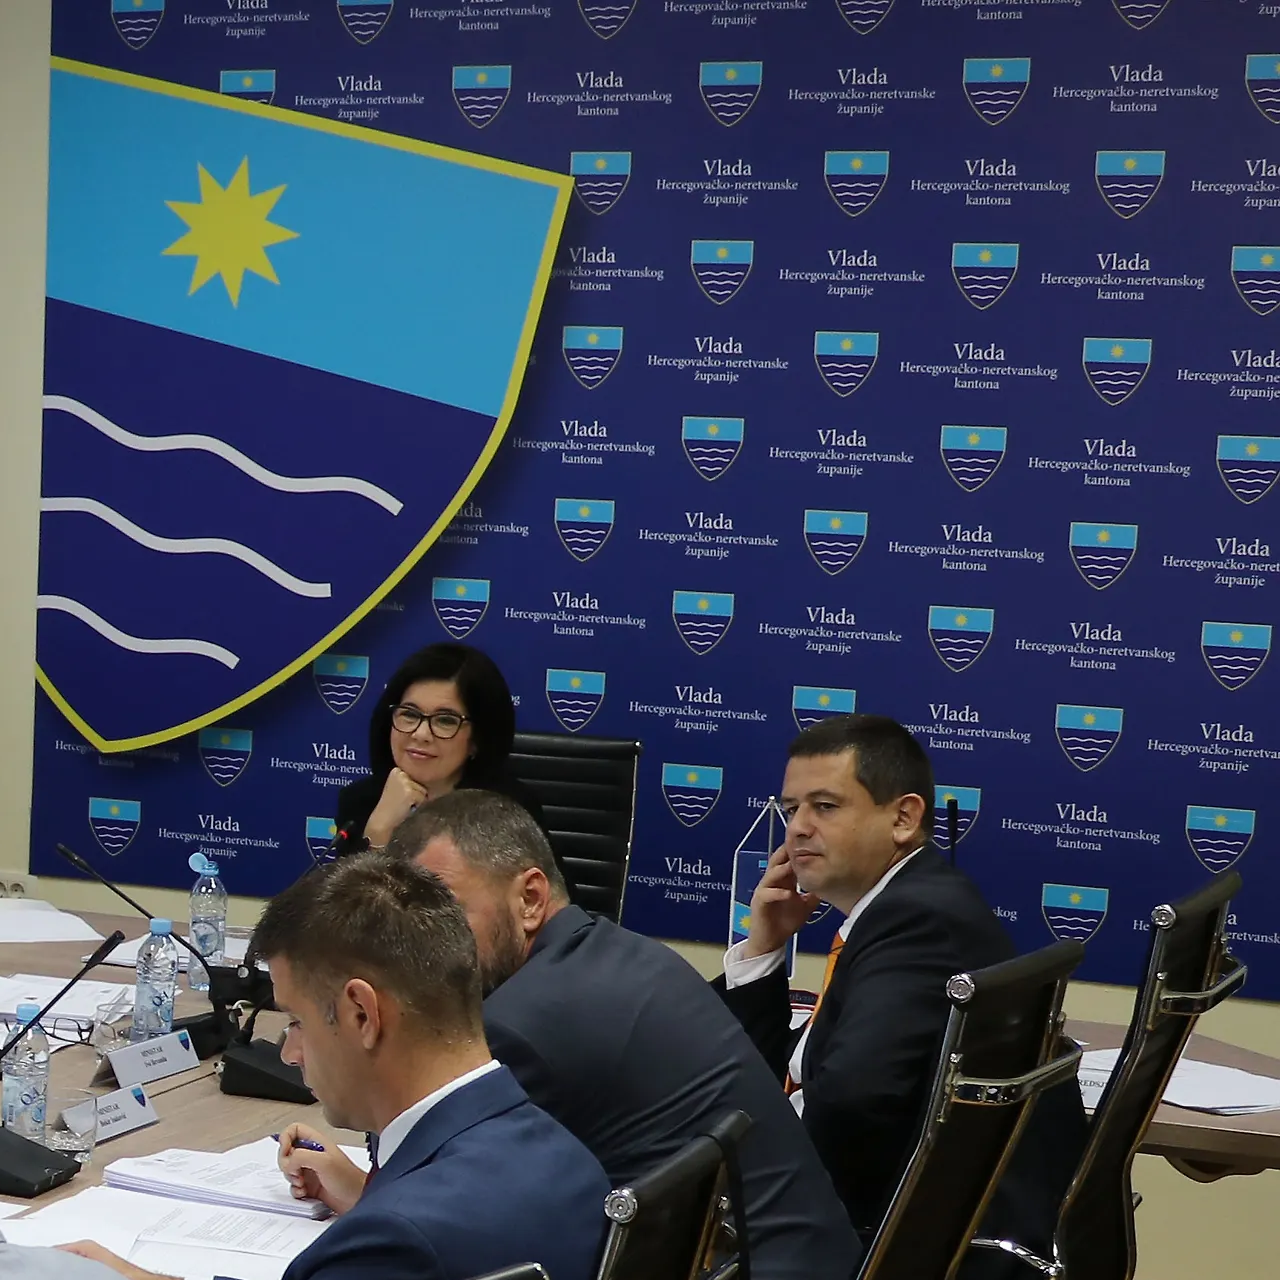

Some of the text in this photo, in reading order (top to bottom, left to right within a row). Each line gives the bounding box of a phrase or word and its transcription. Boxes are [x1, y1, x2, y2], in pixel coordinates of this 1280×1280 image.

[712, 14, 757, 28] županije
[977, 9, 1022, 20] kantona
[226, 27, 266, 39] županije
[459, 20, 499, 30] kantona
[576, 71, 623, 88] Vlada
[838, 68, 887, 85] Vlada
[1110, 64, 1163, 82] Vlada
[338, 75, 382, 91] Vlada
[295, 93, 424, 108] Hercegovačko-neretvanske
[527, 90, 672, 105] Hercegovačko-neretvanskog
[789, 87, 936, 103] Hercegovačko-neretvanske
[1053, 85, 1219, 101] Hercegovačko-neretvanskog
[339, 108, 379, 120] županije
[577, 105, 619, 116] kantona
[837, 103, 884, 117] županije
[1110, 100, 1157, 112] kantona
[704, 159, 751, 175] Vlada
[965, 159, 1016, 176] Vlada
[657, 179, 798, 193] Hercegovačko-neretvanske
[911, 180, 1070, 194] Hercegovačko-neretvanskog
[703, 193, 748, 207] županije
[966, 194, 1011, 205] kantona
[570, 247, 615, 263] Vlada
[828, 249, 877, 266] Vlada
[1097, 253, 1150, 270] Vlada
[779, 269, 925, 283] Hercegovačko-neretvanske
[1041, 273, 1205, 290] Hercegovačko-neretvanskog
[570, 280, 611, 291] kantona
[827, 284, 874, 298] županije
[1097, 288, 1144, 300] kantona
[695, 336, 742, 354] Vlada
[954, 343, 1004, 360] Vlada
[648, 355, 789, 369] Hercegovačko-neretvanske
[694, 370, 739, 384] županije
[900, 362, 1057, 380] Hercegovačko-neretvanskog
[954, 377, 999, 389] kantona
[561, 420, 607, 437] Vlada
[818, 429, 866, 447] Vlada
[514, 438, 655, 456] Hercegovačko-neretvanskog
[769, 447, 914, 463] Hercegovačko-neretvanske
[1084, 439, 1136, 457] Vlada
[562, 452, 603, 464] kantona
[817, 463, 863, 478] županije
[1029, 457, 1190, 477] Hercegovačko-neretvanskog
[1084, 473, 1130, 486] kantona
[685, 512, 733, 530] Vlada
[639, 529, 778, 546] Hercegovačko-neretvanske
[942, 524, 992, 542] Vlada
[685, 545, 729, 560] županije
[889, 541, 1044, 563] Hercegovačko-neretvanskog
[1216, 538, 1269, 556] Vlada
[942, 558, 987, 571] kantona
[1215, 573, 1265, 588] županije
[553, 592, 598, 609] Vlada
[505, 607, 646, 629] Hercegovačko-neretvanskog
[807, 607, 855, 625] Vlada
[554, 623, 594, 636] kantona
[759, 623, 902, 642] Hercegovačko-neretvanske
[1070, 622, 1122, 641] Vlada
[806, 640, 851, 655] županije
[1015, 639, 1175, 662] Hercegovačko-neretvanskog
[1070, 656, 1116, 670] kantona
[675, 686, 722, 704] Vlada
[629, 701, 767, 721] Hercegovačko-neretvanske
[929, 704, 979, 722] Vlada
[674, 718, 718, 734] županije
[1201, 723, 1254, 742] Vlada
[312, 743, 355, 760] Vlada
[929, 737, 973, 750] kantona
[1199, 758, 1249, 774] županije
[312, 774, 353, 787] županije
[1056, 803, 1107, 823] Vlada
[198, 814, 240, 832] Vlada
[1002, 819, 1160, 843] Hercegovačko-neretvanskog
[159, 828, 280, 848] Hercegovačko-neretvanske
[1056, 836, 1101, 851] kantona
[200, 844, 237, 859] županije
[665, 857, 711, 876] Vlada
[664, 889, 708, 904] županije
